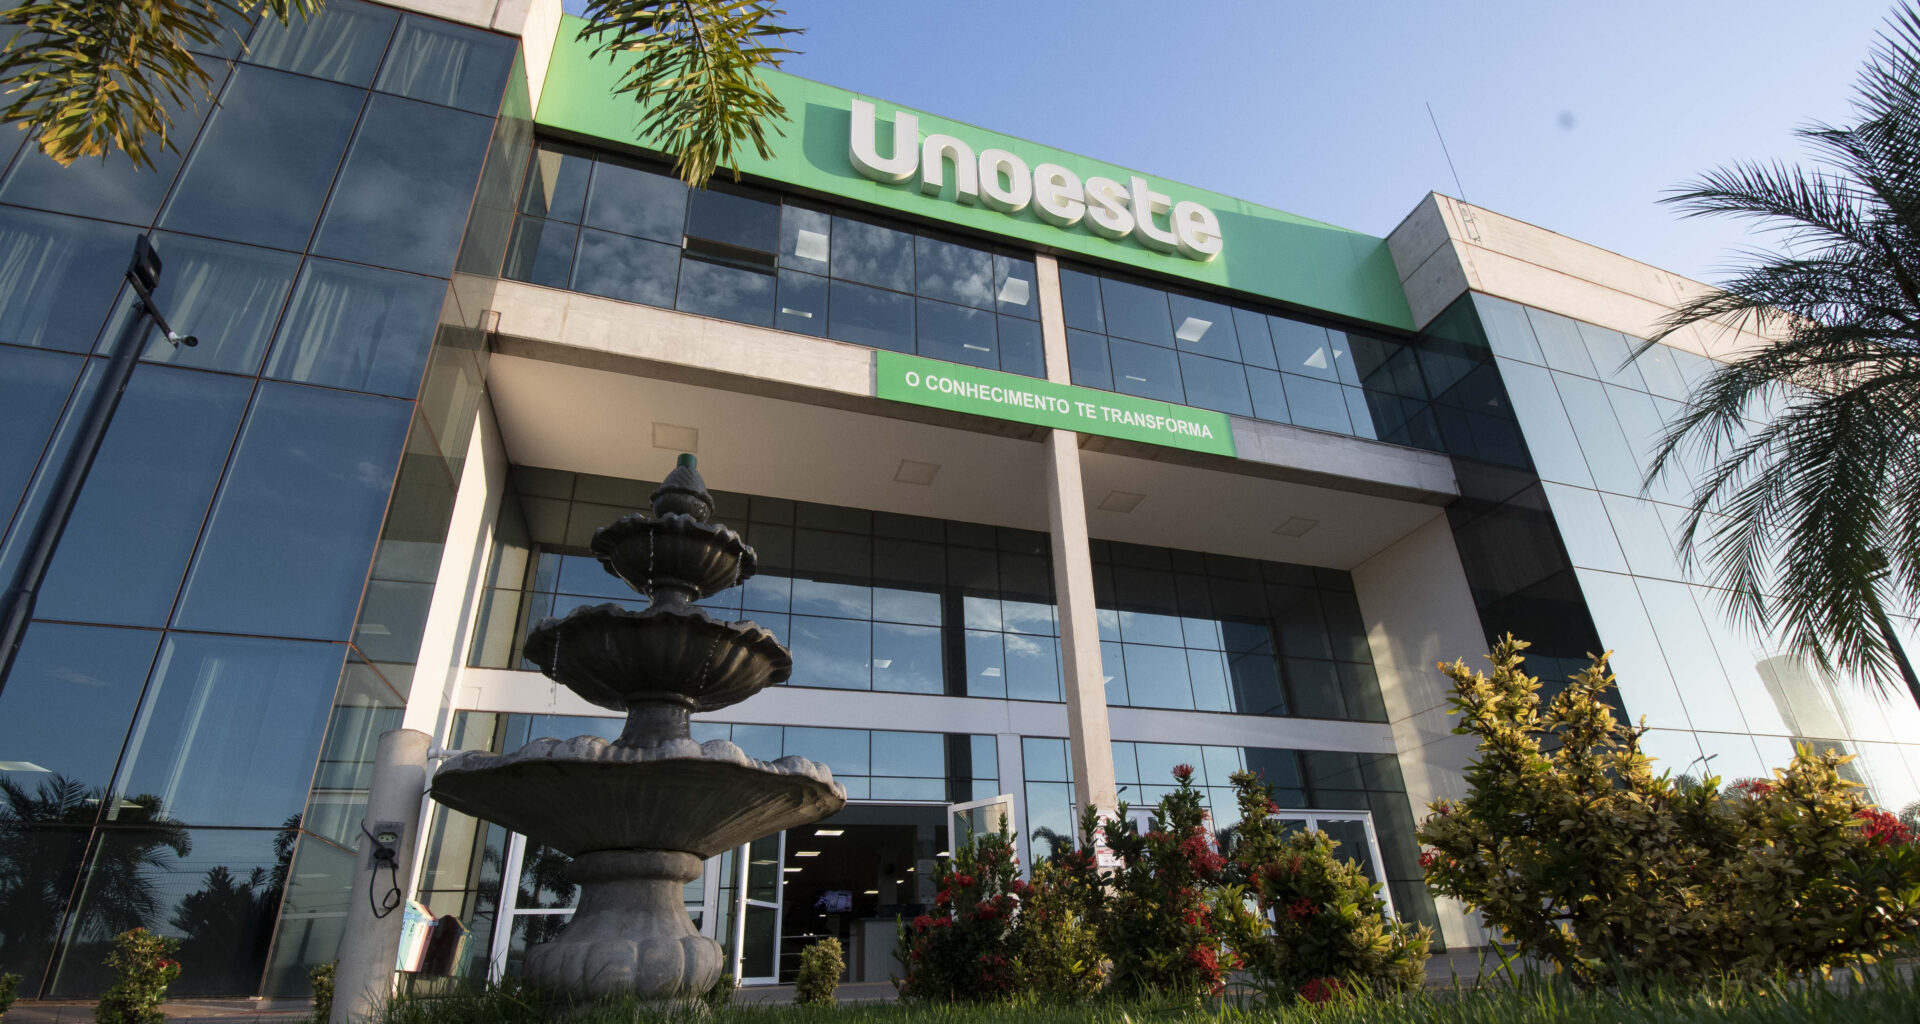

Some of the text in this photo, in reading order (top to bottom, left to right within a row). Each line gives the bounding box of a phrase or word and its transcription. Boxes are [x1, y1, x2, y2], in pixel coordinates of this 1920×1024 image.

[849, 98, 1224, 262] Unoeste
[905, 371, 1213, 440] O CONHECIMENTO TE TRANSFORMA
